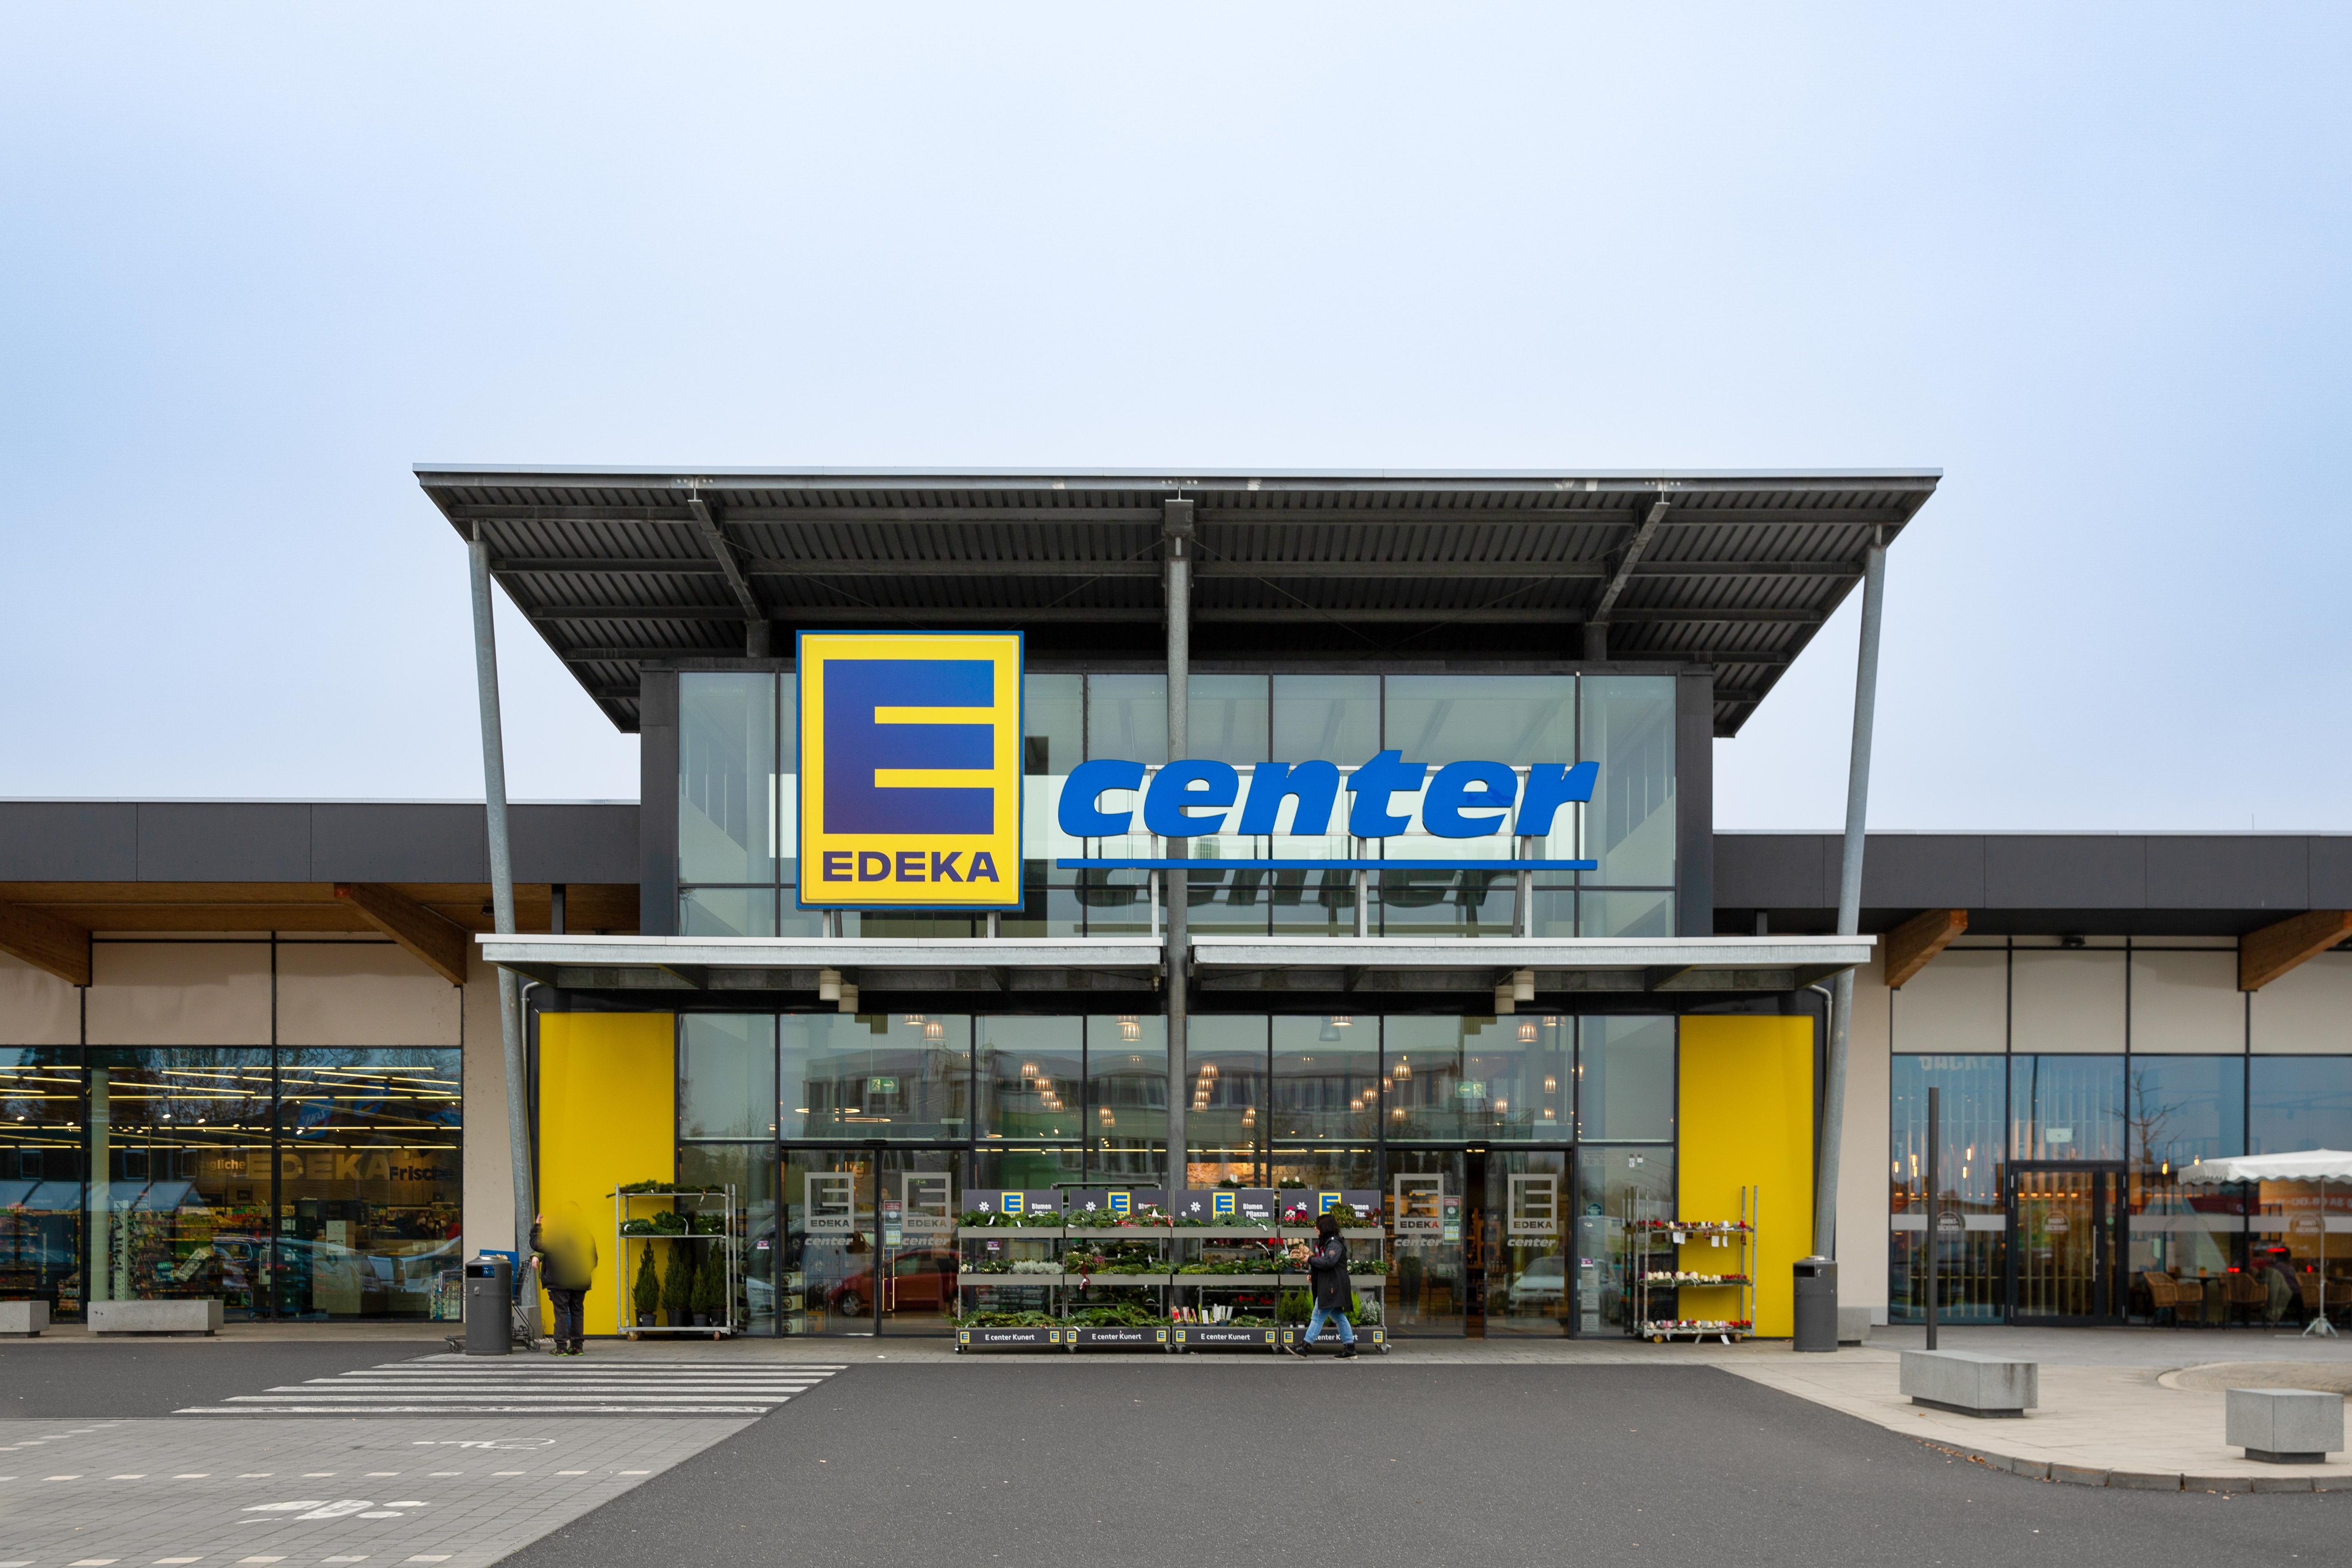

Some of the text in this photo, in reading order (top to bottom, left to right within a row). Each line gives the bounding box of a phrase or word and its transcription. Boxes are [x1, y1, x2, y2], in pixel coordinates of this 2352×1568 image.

[823, 659, 994, 834] E
[1058, 750, 1600, 838] center
[823, 851, 999, 882] EDEKA
[246, 1154, 390, 1179] EDEKA
[1004, 1195, 1021, 1211] E
[1111, 1195, 1127, 1211] E
[1216, 1195, 1232, 1211] E
[805, 1237, 853, 1245] center
[902, 1237, 951, 1246] center
[1394, 1238, 1443, 1246] center
[1507, 1238, 1556, 1247] center
